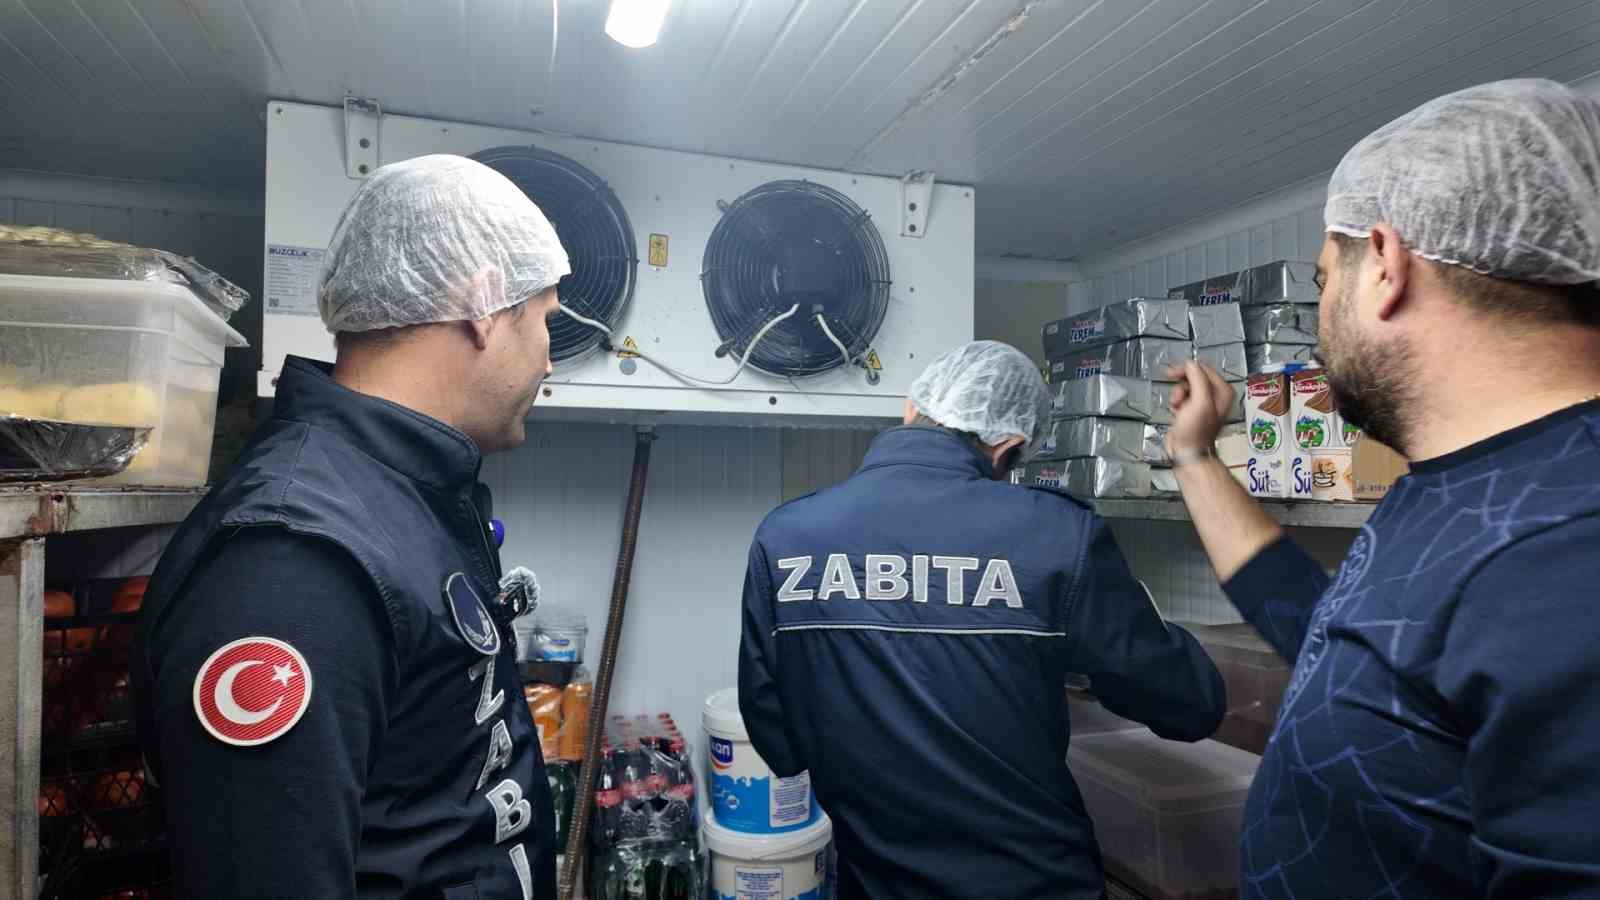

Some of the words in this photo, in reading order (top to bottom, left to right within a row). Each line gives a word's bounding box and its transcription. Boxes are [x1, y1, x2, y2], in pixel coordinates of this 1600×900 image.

[1248, 459, 1270, 493] Süt
[1292, 459, 1312, 493] Sü
[777, 553, 1023, 608] ZABITA
